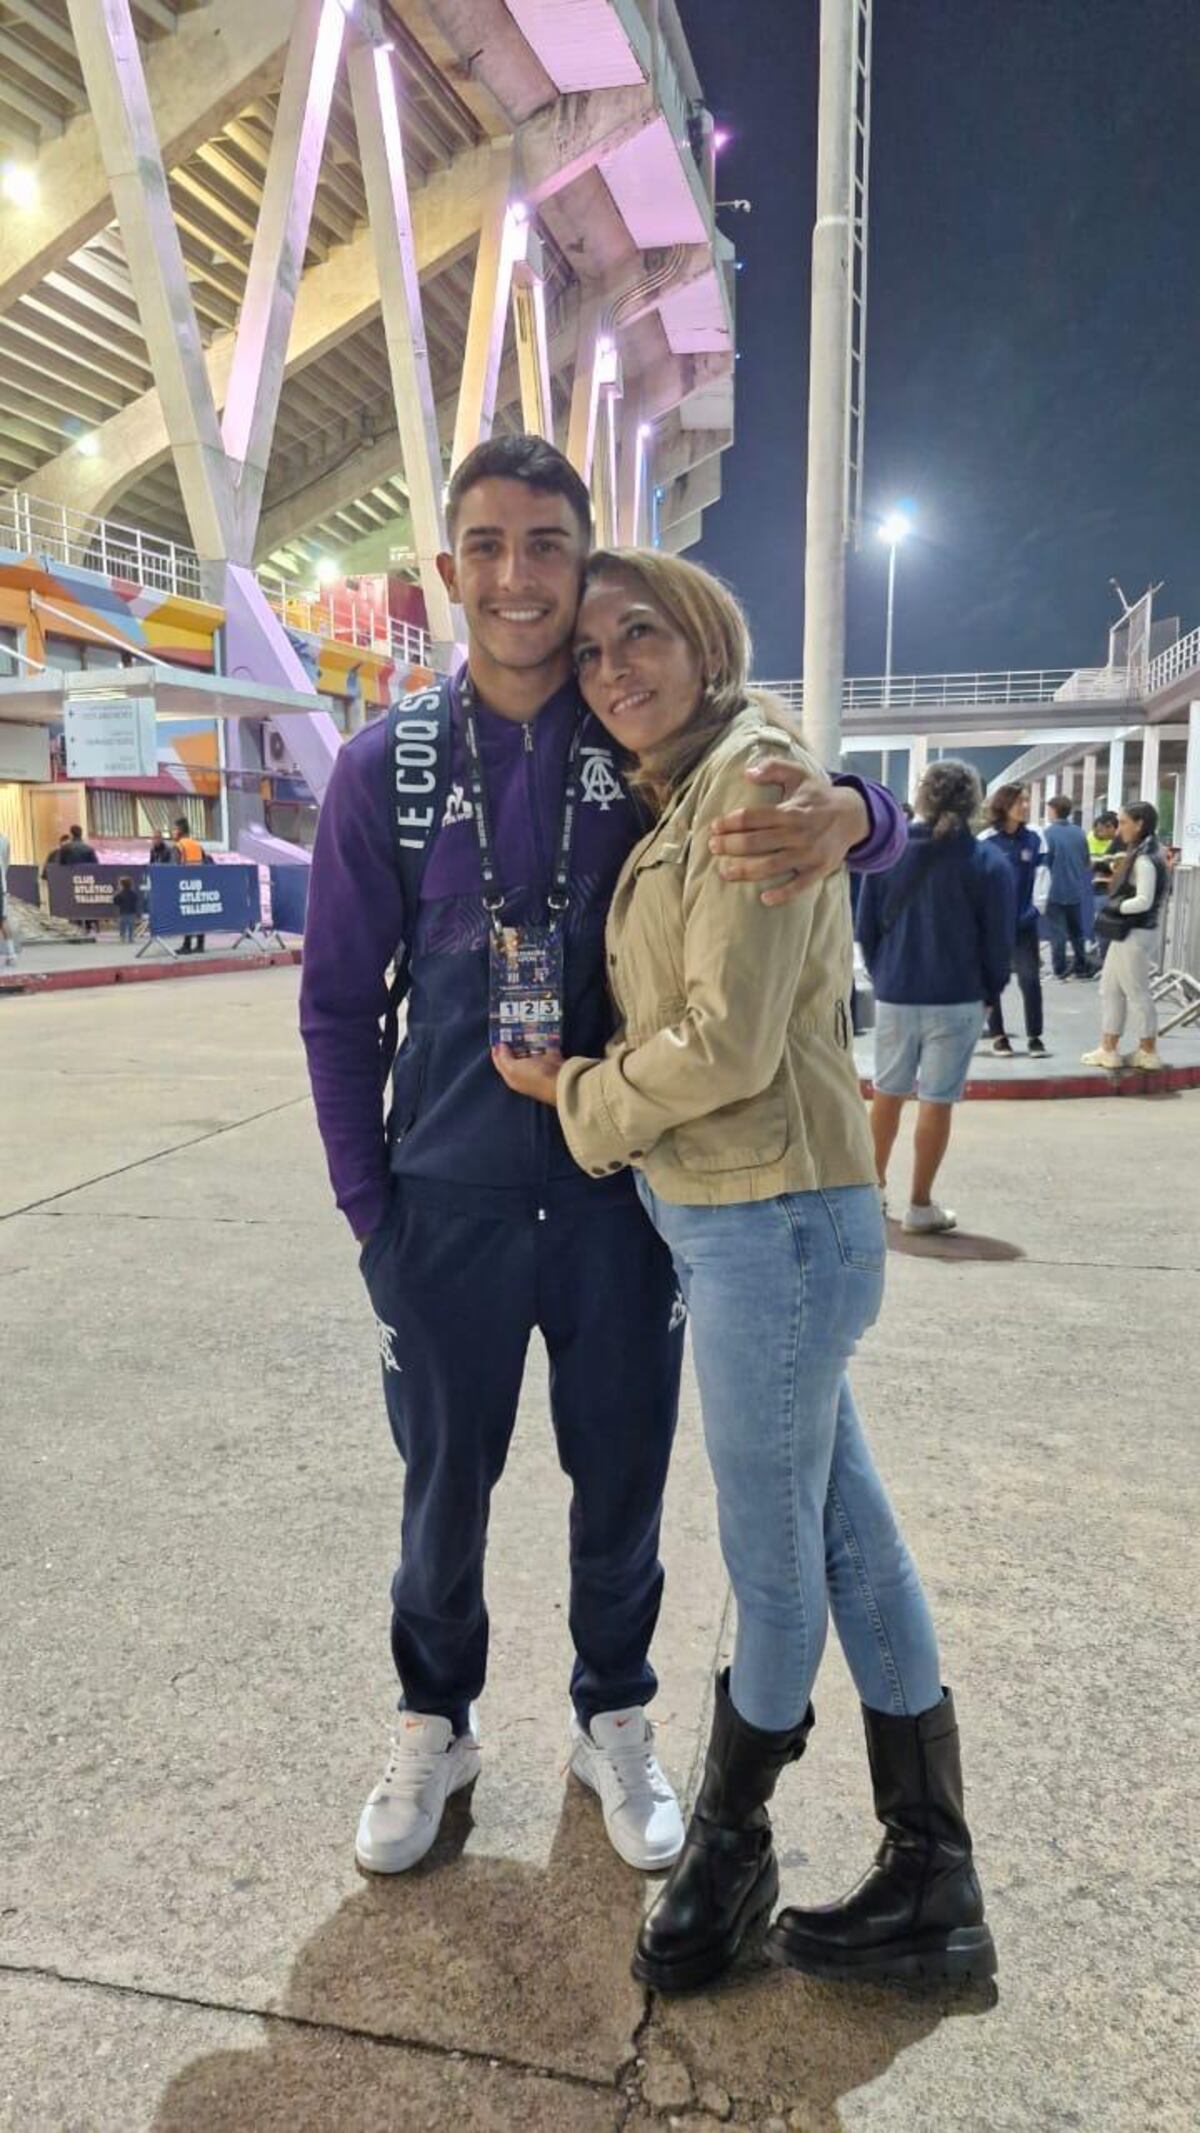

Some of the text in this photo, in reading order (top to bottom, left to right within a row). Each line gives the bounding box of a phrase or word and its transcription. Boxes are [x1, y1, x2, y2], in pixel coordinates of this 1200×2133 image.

[395, 719, 440, 794] COQ
[72, 875, 95, 884] CLUB
[179, 879, 203, 891] CLUB
[179, 890, 221, 902] ATLÉTICO
[180, 902, 223, 916] TALLERES
[506, 1002, 554, 1016] 1 2 3
